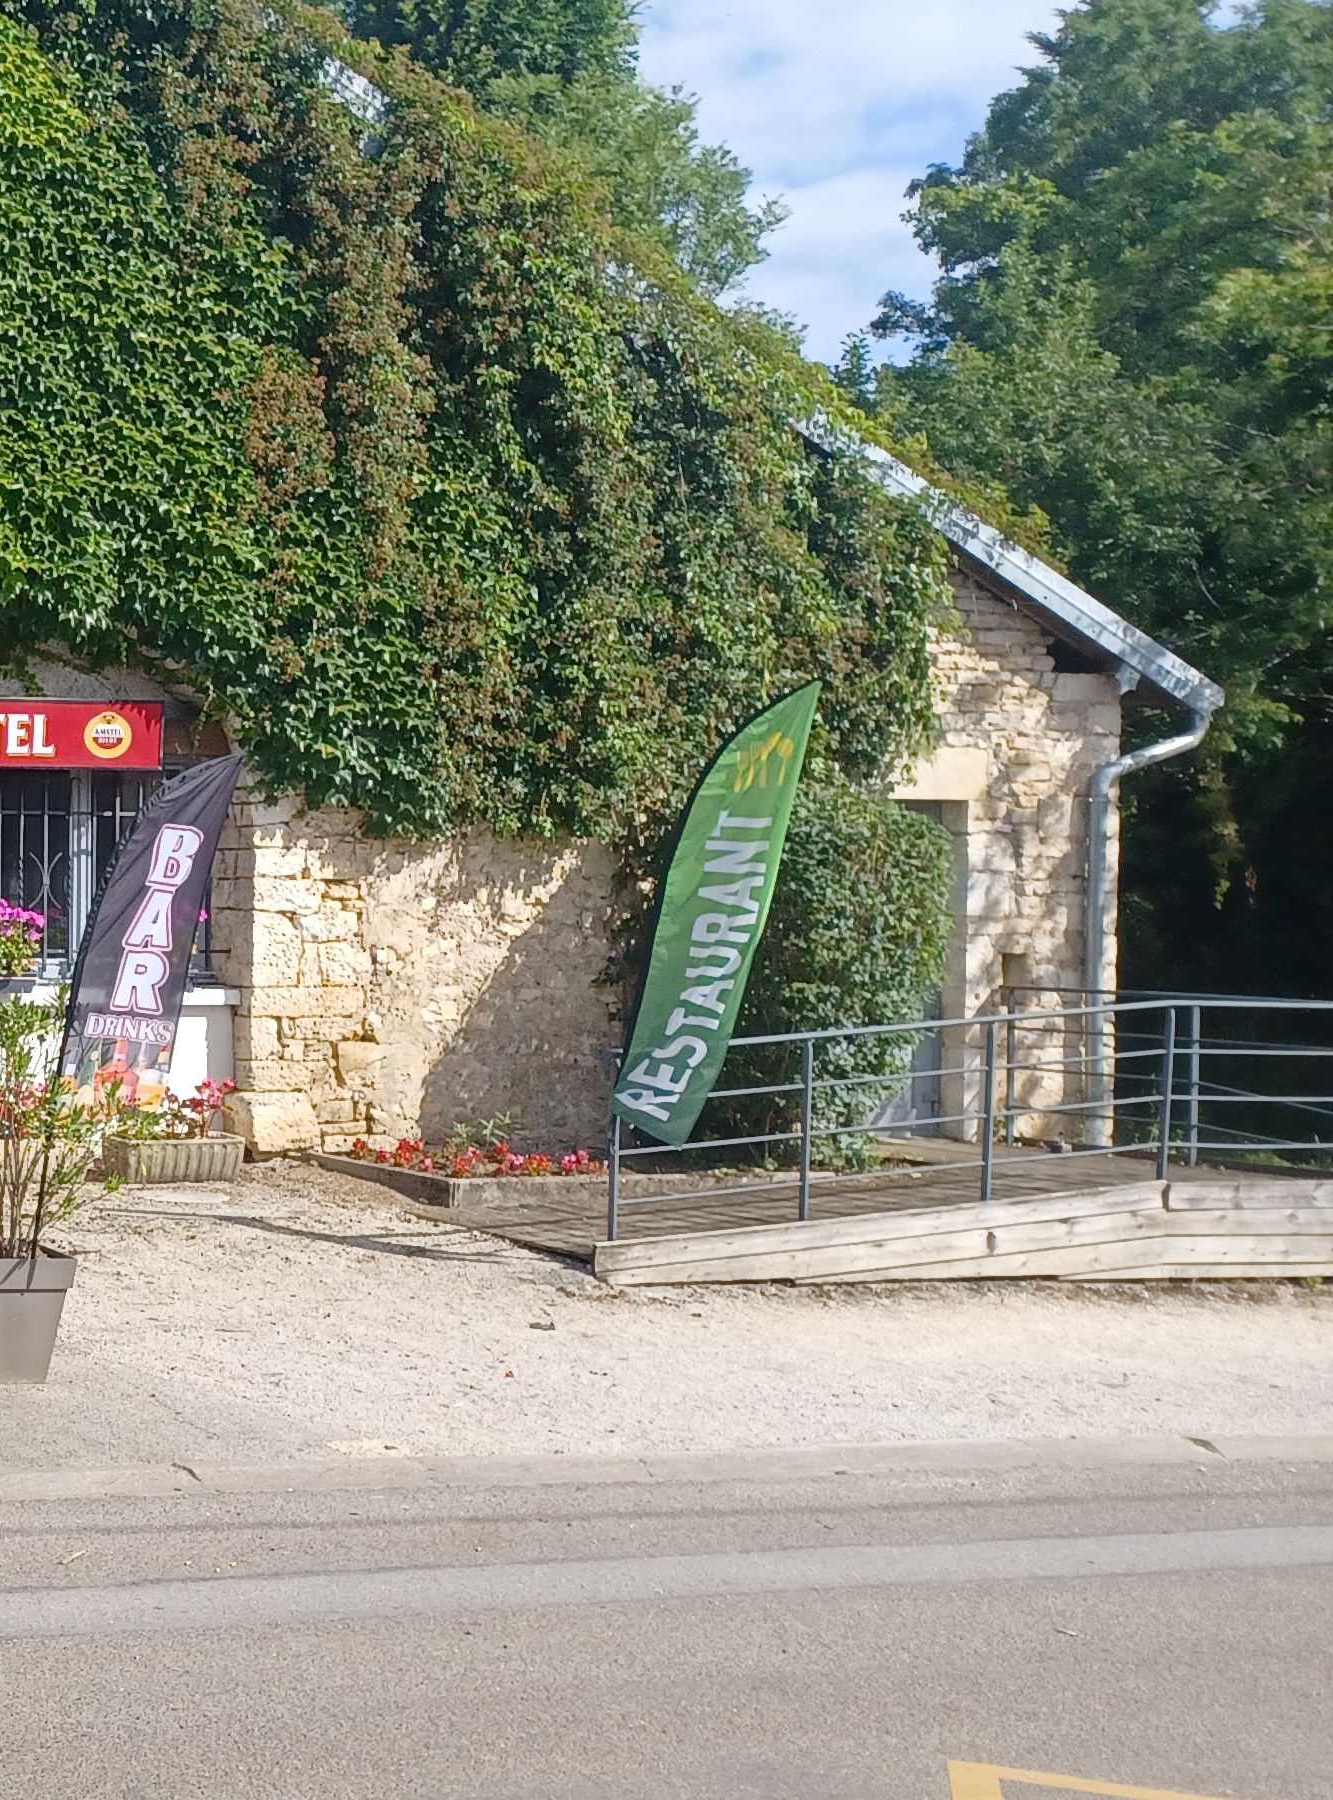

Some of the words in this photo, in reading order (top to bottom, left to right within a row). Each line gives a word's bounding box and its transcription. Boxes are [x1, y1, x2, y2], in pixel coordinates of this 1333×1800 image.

[109, 823, 205, 1015] BAR
[614, 810, 773, 1122] RESTAURANT
[84, 1012, 176, 1045] DRINKS
